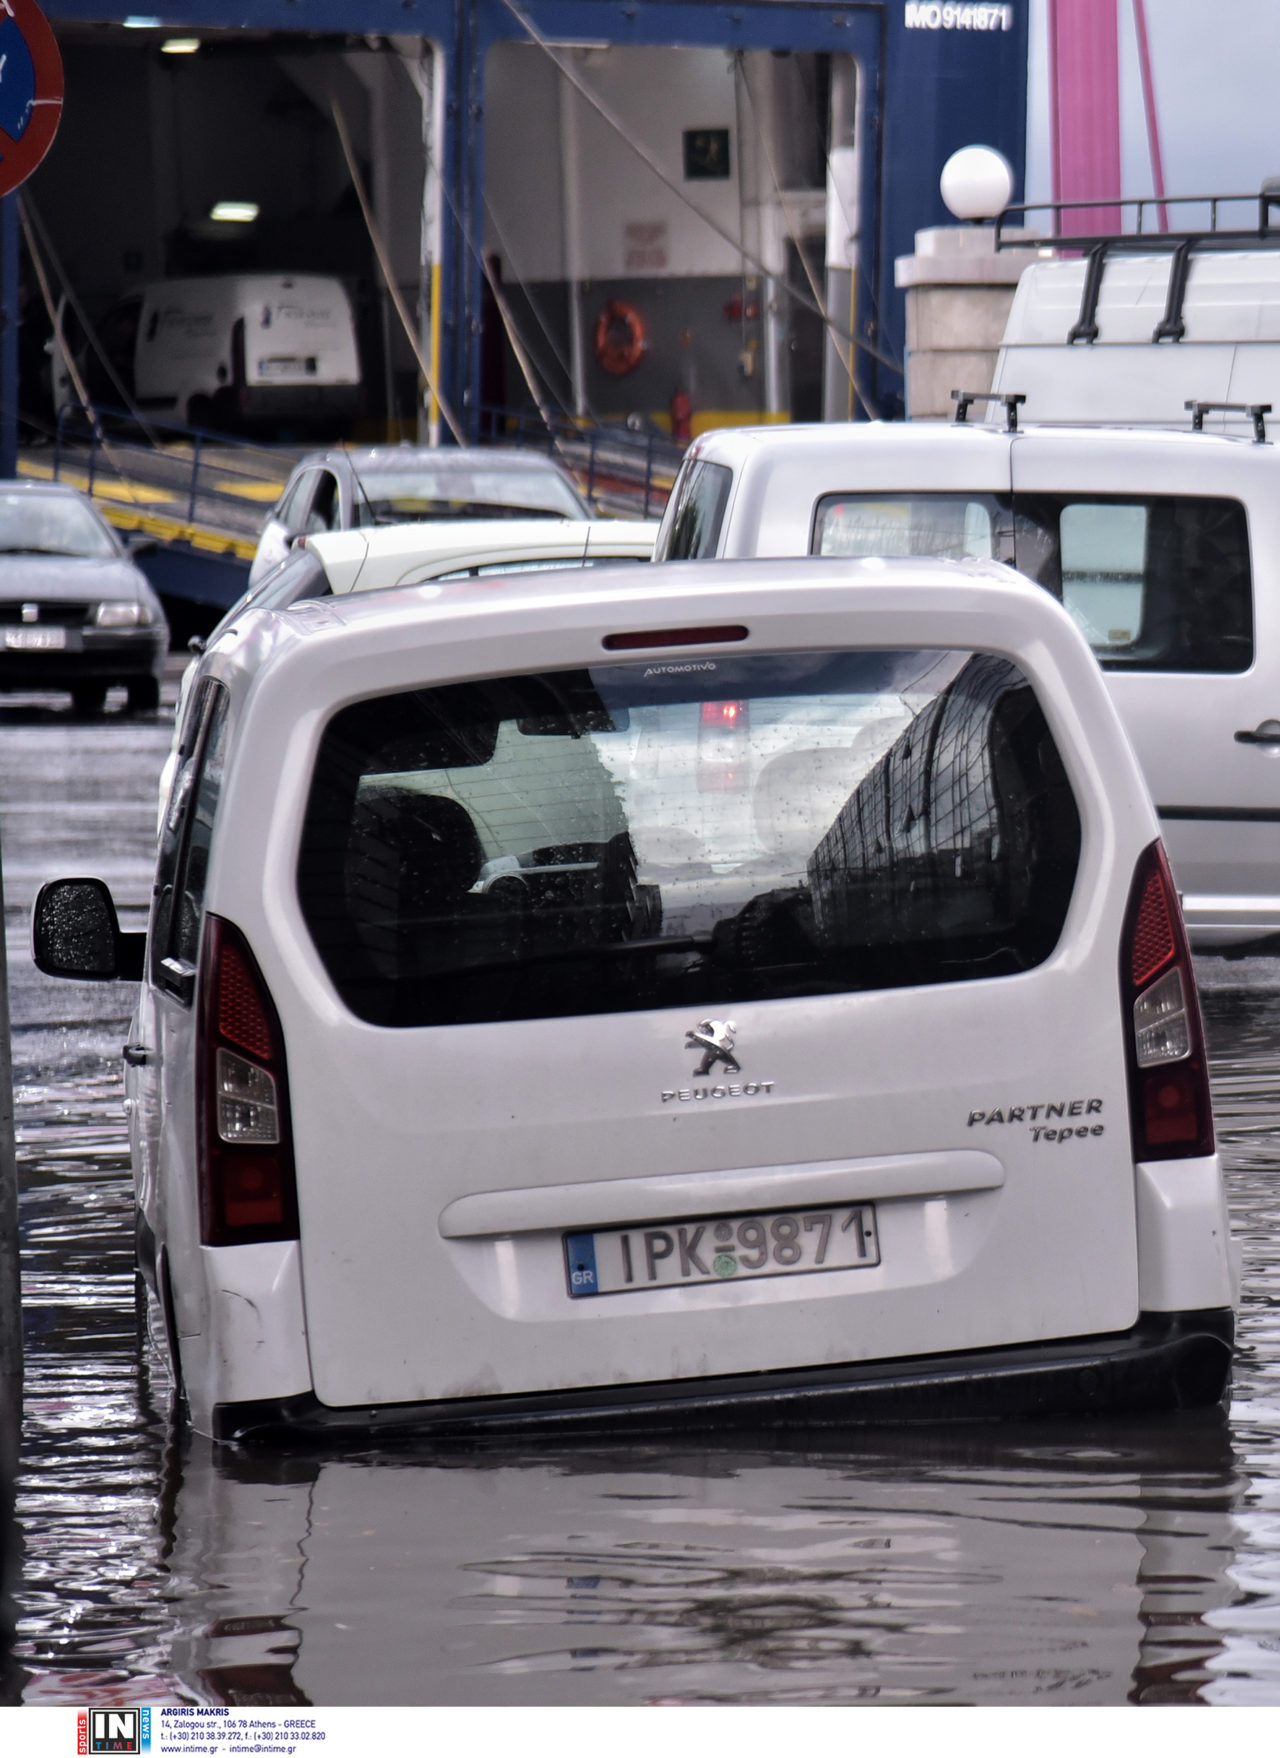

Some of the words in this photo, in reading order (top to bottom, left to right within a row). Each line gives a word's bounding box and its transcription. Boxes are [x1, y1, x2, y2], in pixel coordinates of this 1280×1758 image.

[643, 661, 717, 678] AUTOMOTIVO
[661, 1081, 775, 1103] PEUGEOT
[967, 1099, 1103, 1127] PARTNER
[1029, 1124, 1104, 1143] Tepee
[571, 1269, 594, 1285] GR
